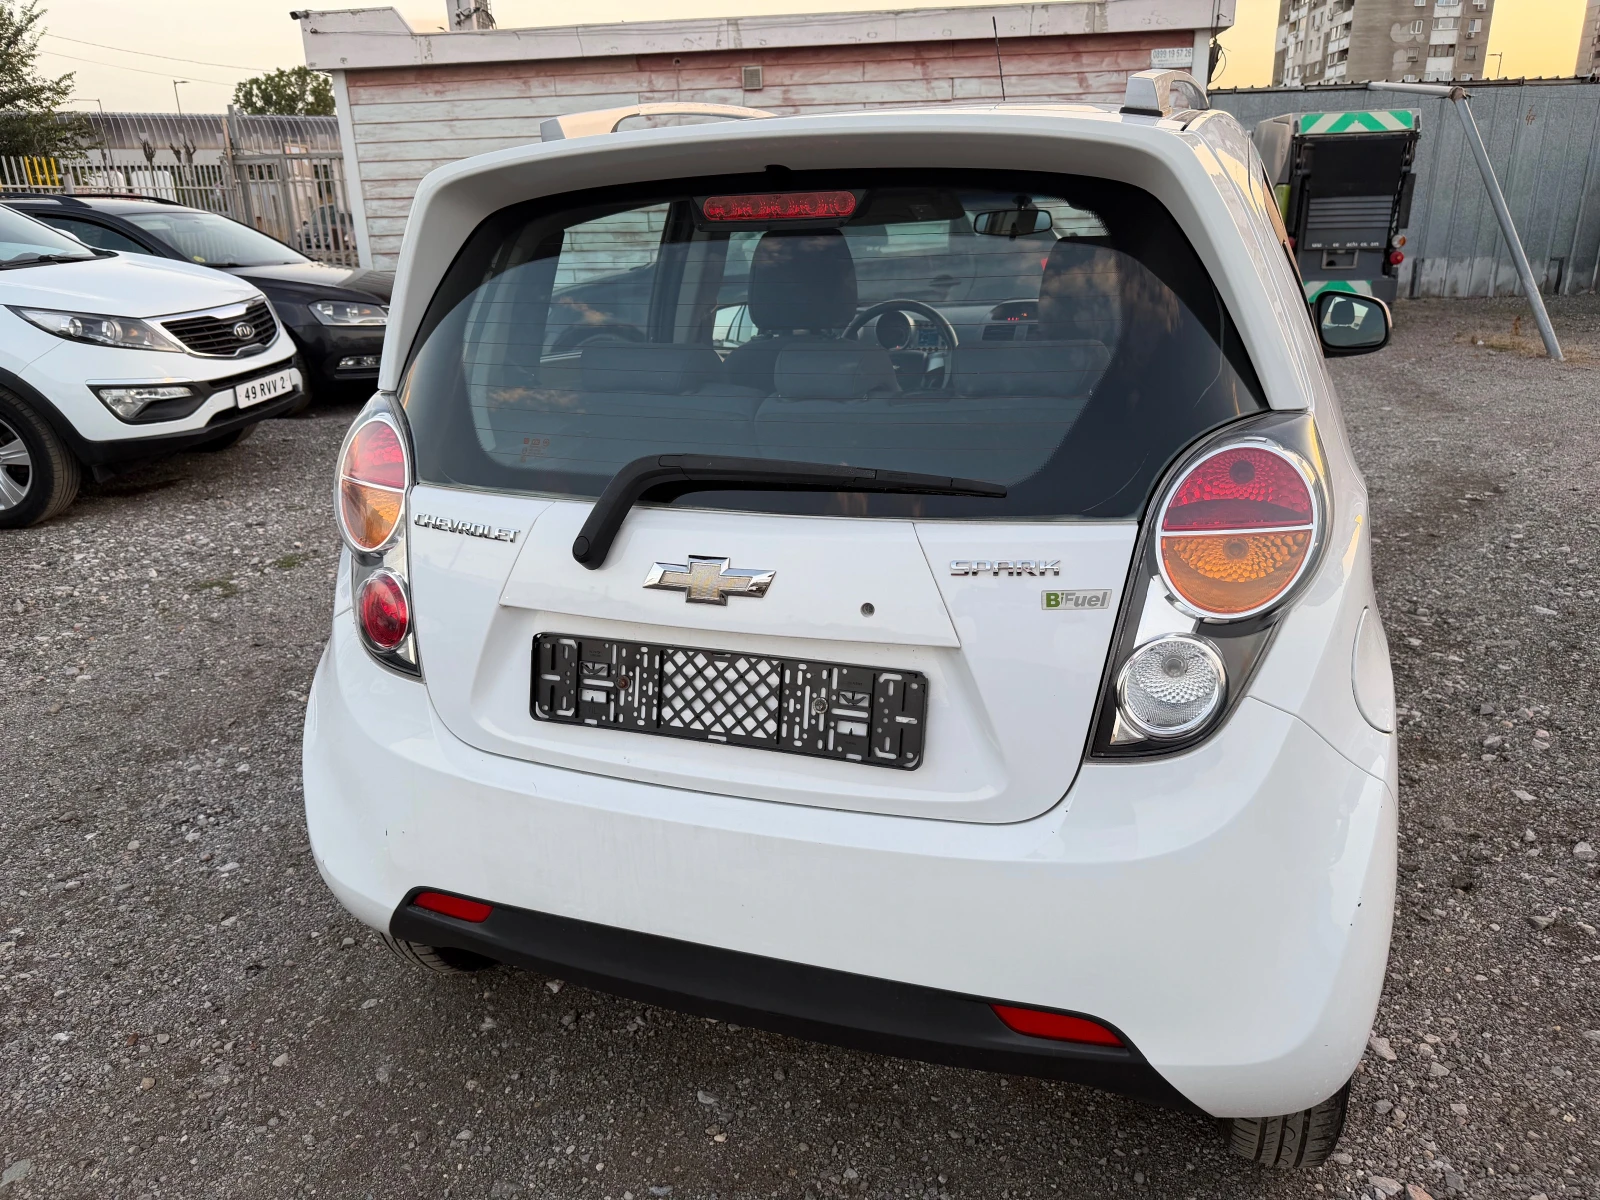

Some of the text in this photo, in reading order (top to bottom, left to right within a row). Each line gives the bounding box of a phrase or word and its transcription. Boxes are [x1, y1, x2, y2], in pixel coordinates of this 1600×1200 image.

[236, 325, 252, 337] KIA
[244, 376, 286, 401] 49 RVV 2
[414, 512, 521, 543] CHEVROLET
[950, 559, 1061, 577] SPARK
[1045, 591, 1108, 608] BiFuel
